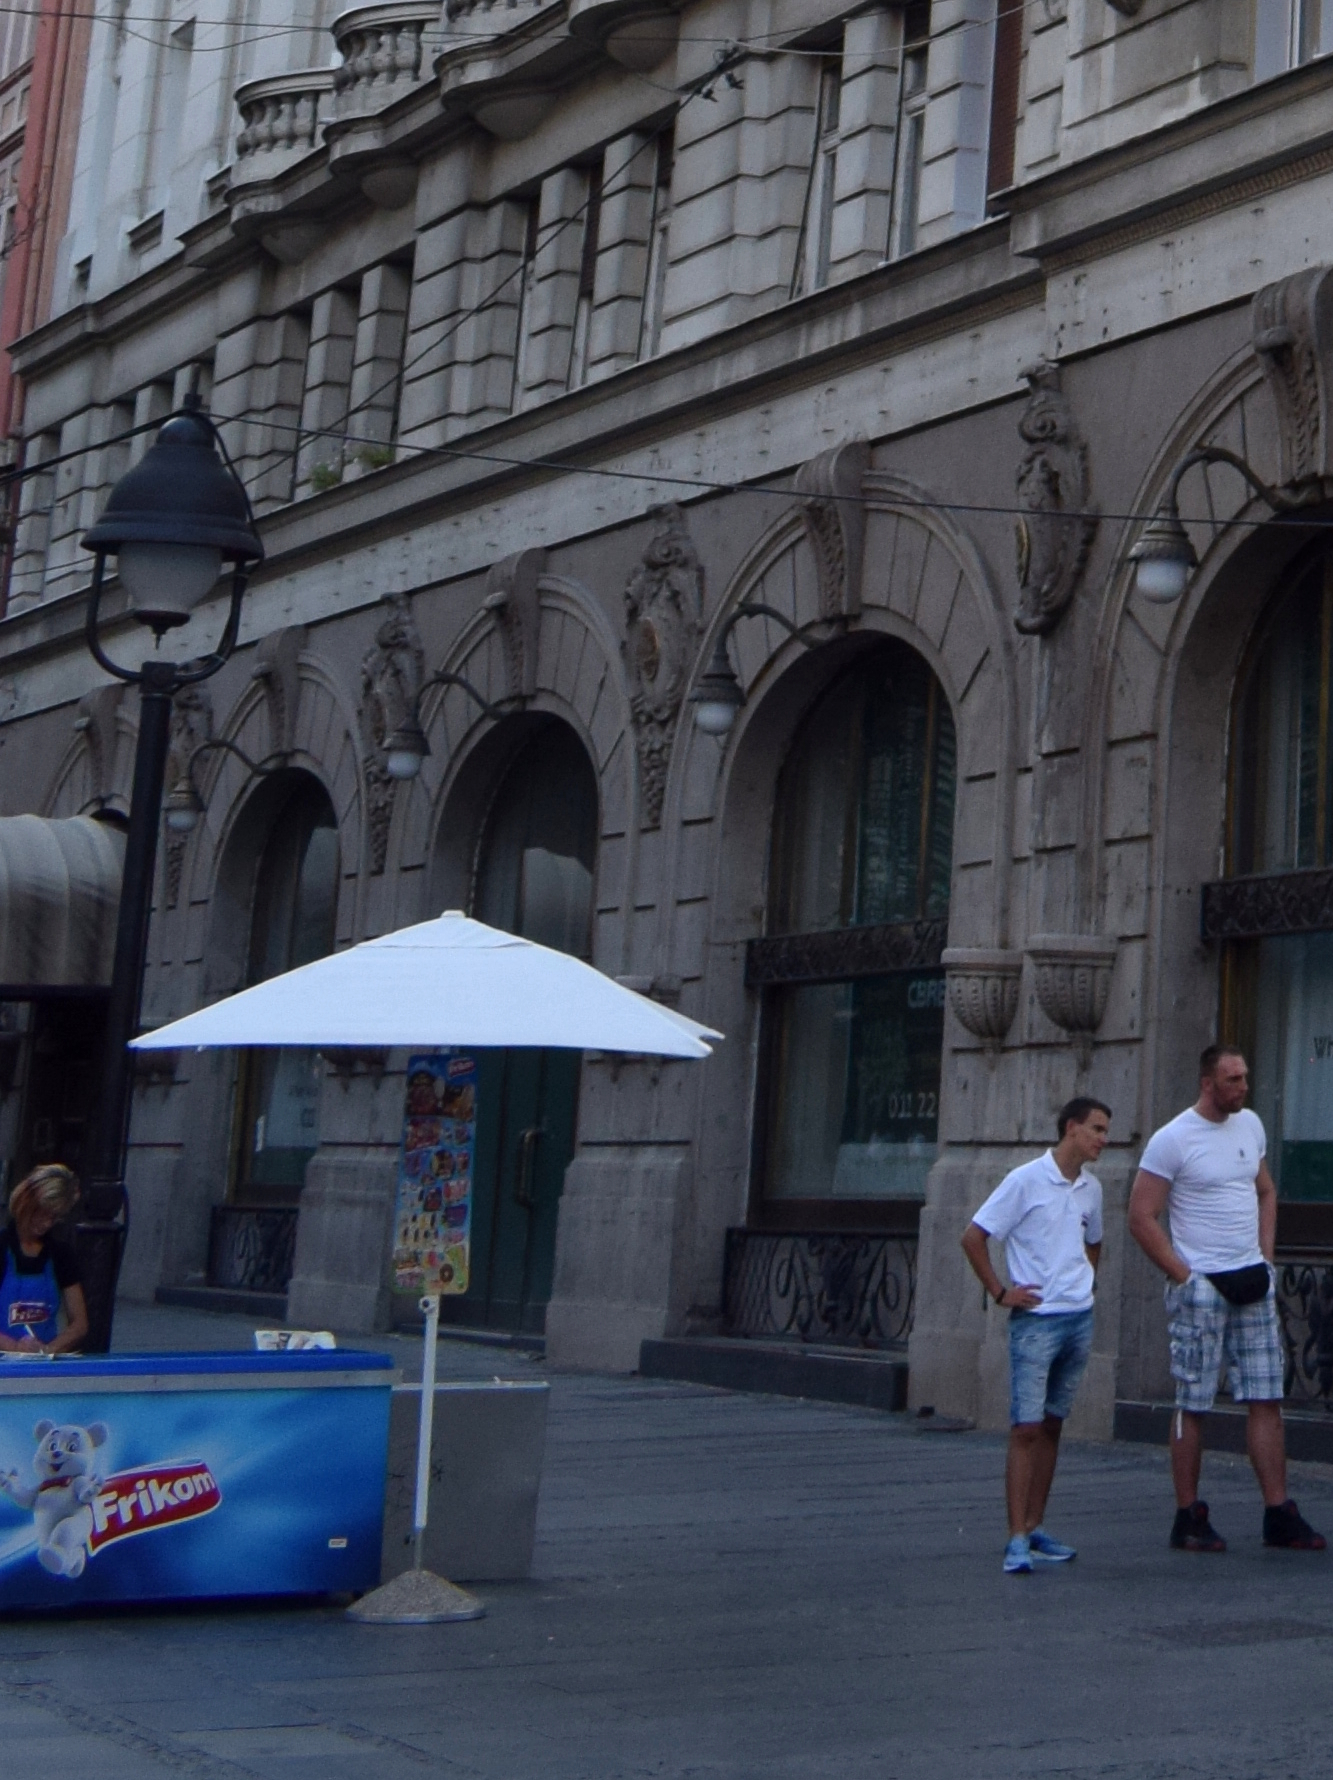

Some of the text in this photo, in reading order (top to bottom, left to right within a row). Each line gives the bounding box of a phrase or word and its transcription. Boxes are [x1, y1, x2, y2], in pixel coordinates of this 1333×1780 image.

[888, 1092, 936, 1118] 011 22
[93, 1470, 217, 1533] Frikom
